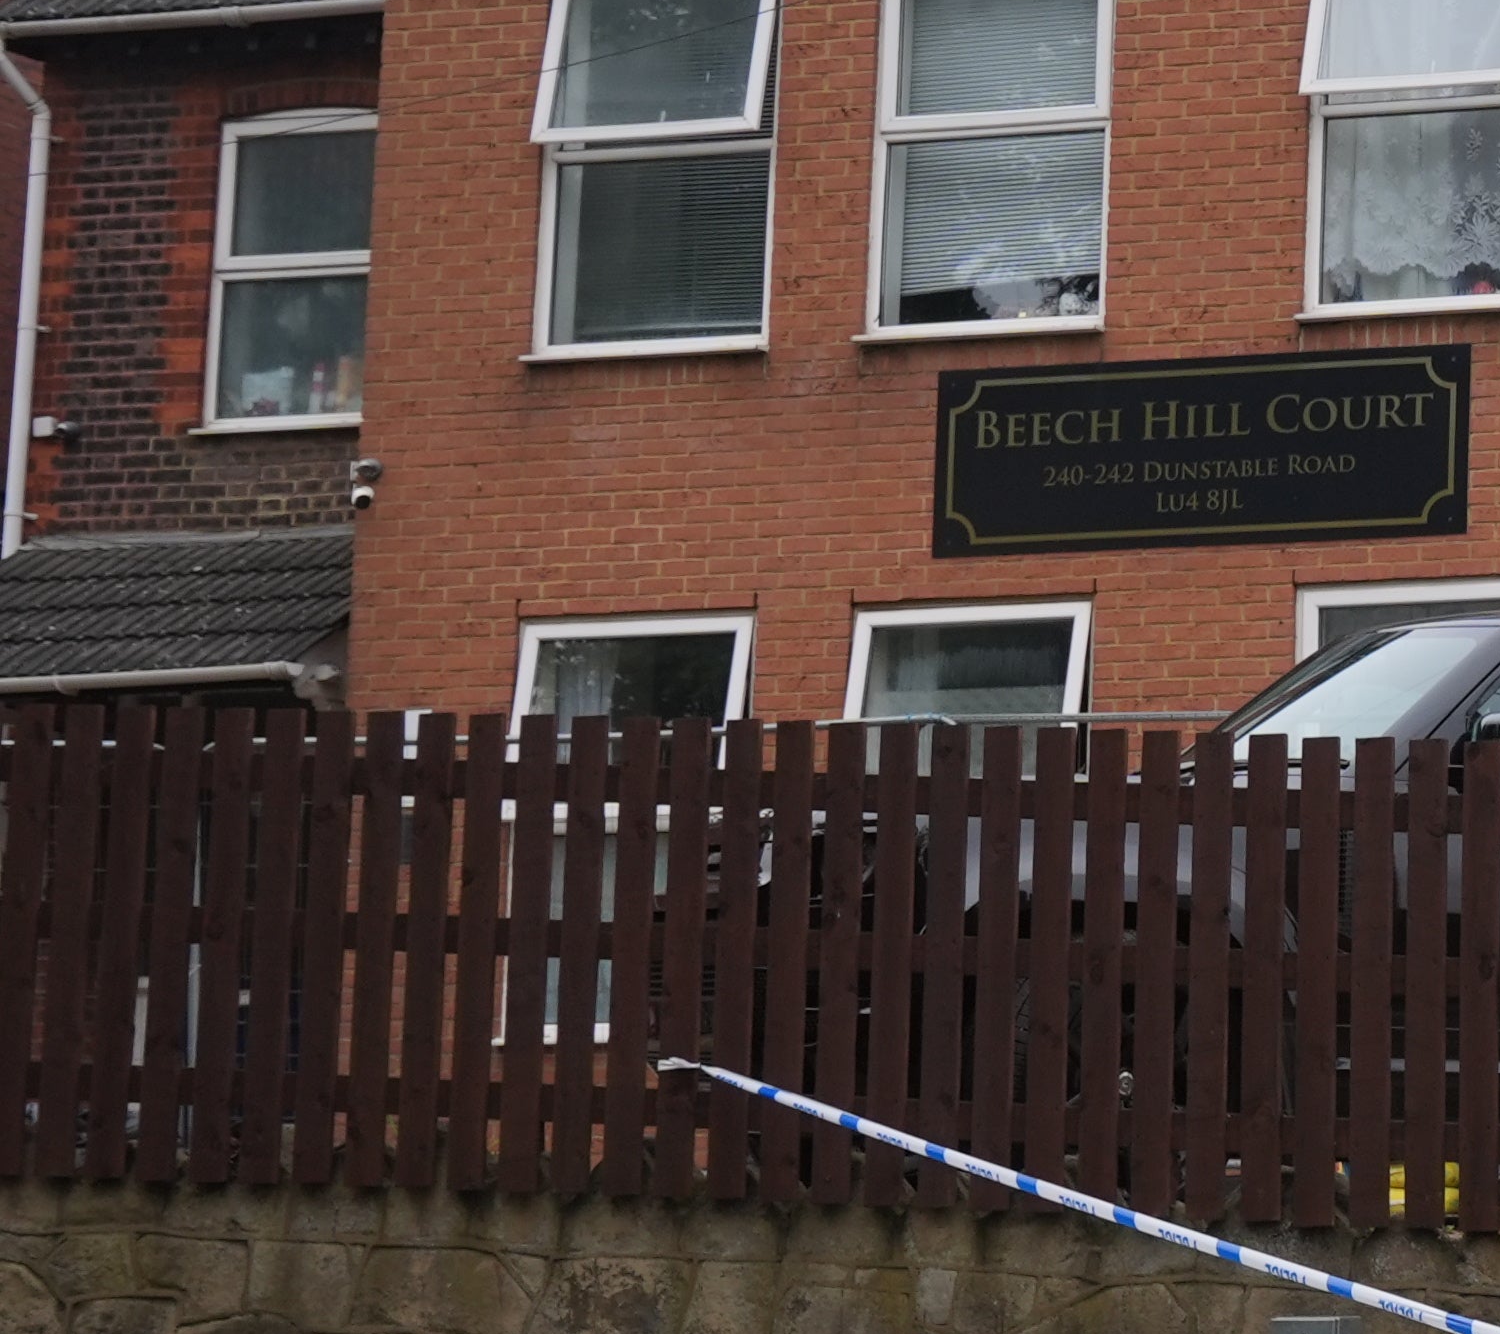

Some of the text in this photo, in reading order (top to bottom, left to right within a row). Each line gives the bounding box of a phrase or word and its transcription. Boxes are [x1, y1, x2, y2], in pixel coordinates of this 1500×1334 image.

[975, 393, 1434, 449] BEECH HILL COURT
[1043, 454, 1356, 487] 240-242 DUNSTABLE ROAD
[1207, 489, 1245, 514] 8JL
